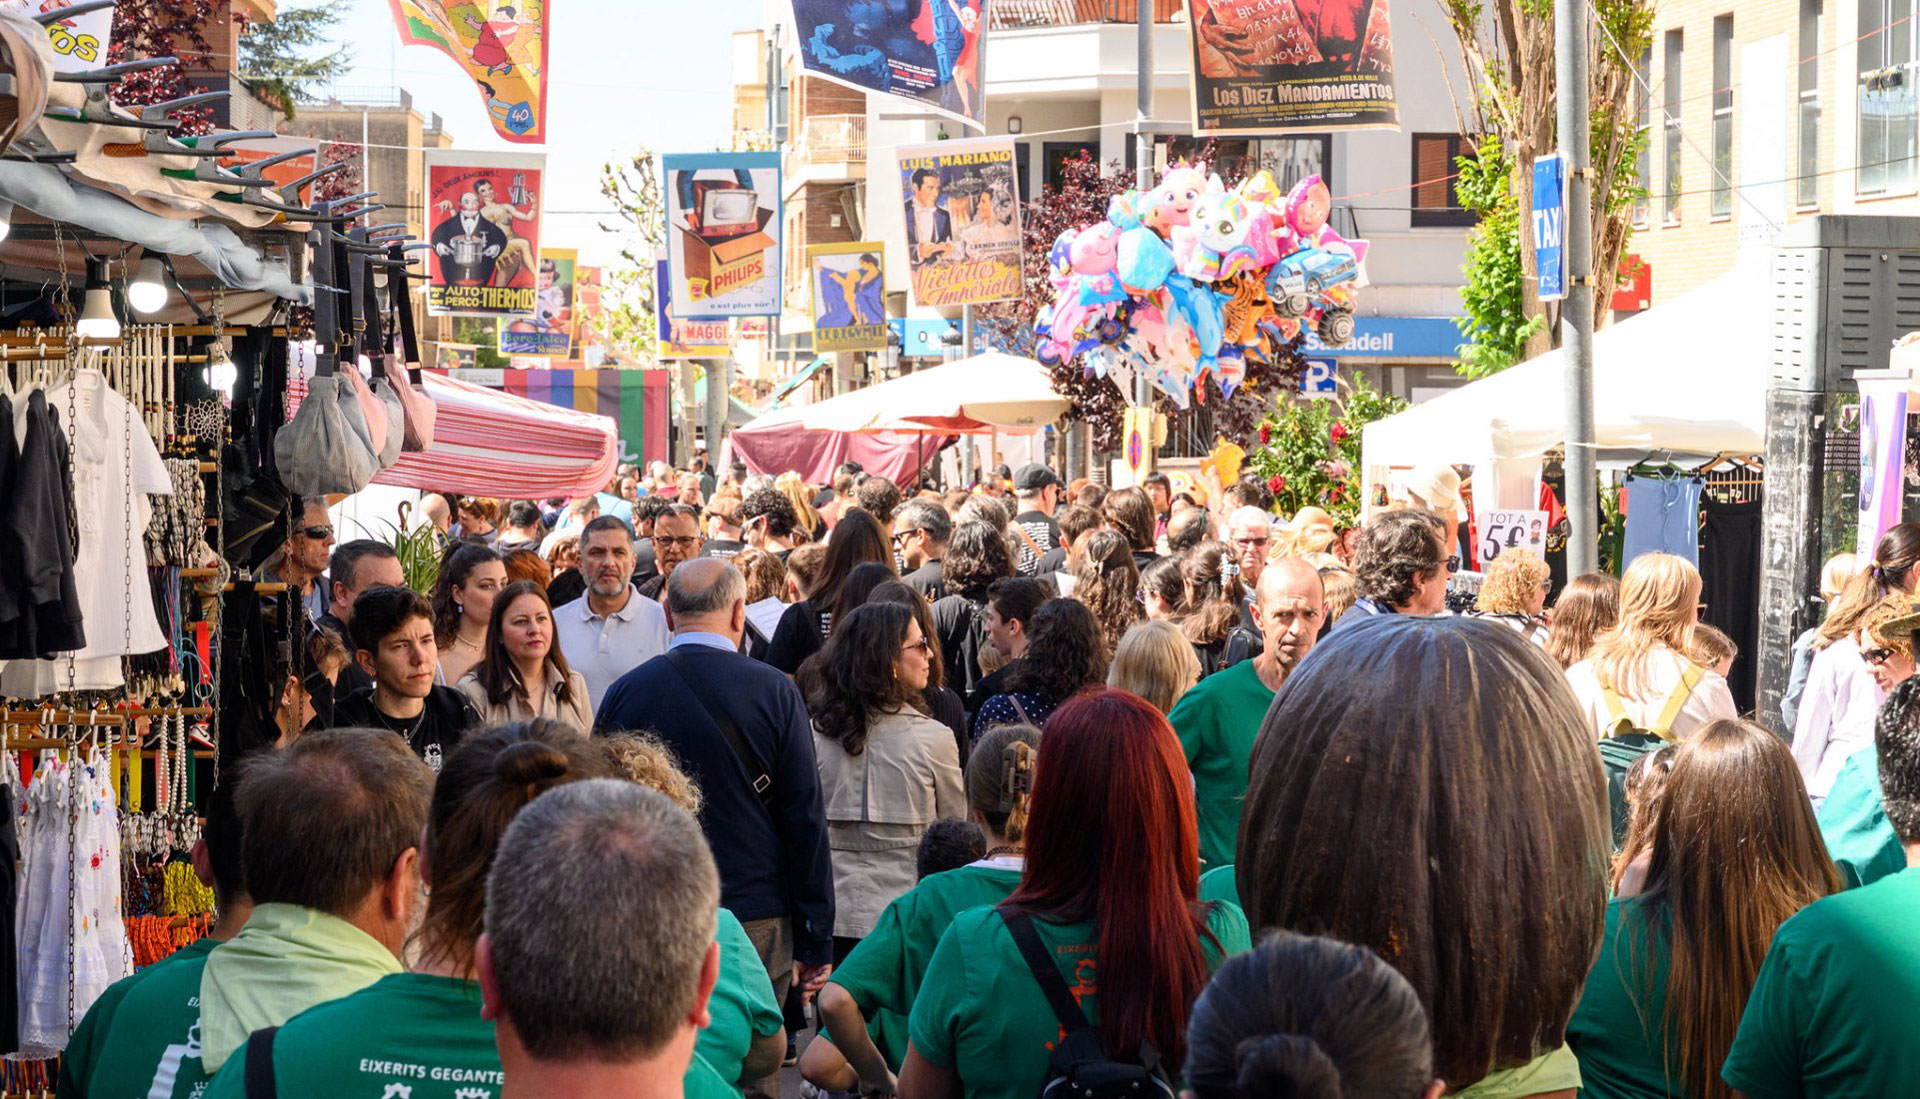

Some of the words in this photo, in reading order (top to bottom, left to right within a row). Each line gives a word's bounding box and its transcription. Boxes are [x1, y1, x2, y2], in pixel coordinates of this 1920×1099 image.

[1213, 87, 1240, 106] LOS
[1242, 86, 1275, 106] DIEZ
[1277, 82, 1394, 104] MANDAMIENTOS
[512, 109, 529, 121] 40
[902, 156, 935, 171] LUIS
[939, 150, 1013, 167] MARIANO
[712, 260, 763, 291] PHILIPS
[481, 287, 536, 309] THERMOS
[686, 323, 728, 340] MAGGI
[1489, 513, 1513, 525] TOT
[1517, 514, 1527, 525] A
[359, 1058, 427, 1079] EIXERITS
